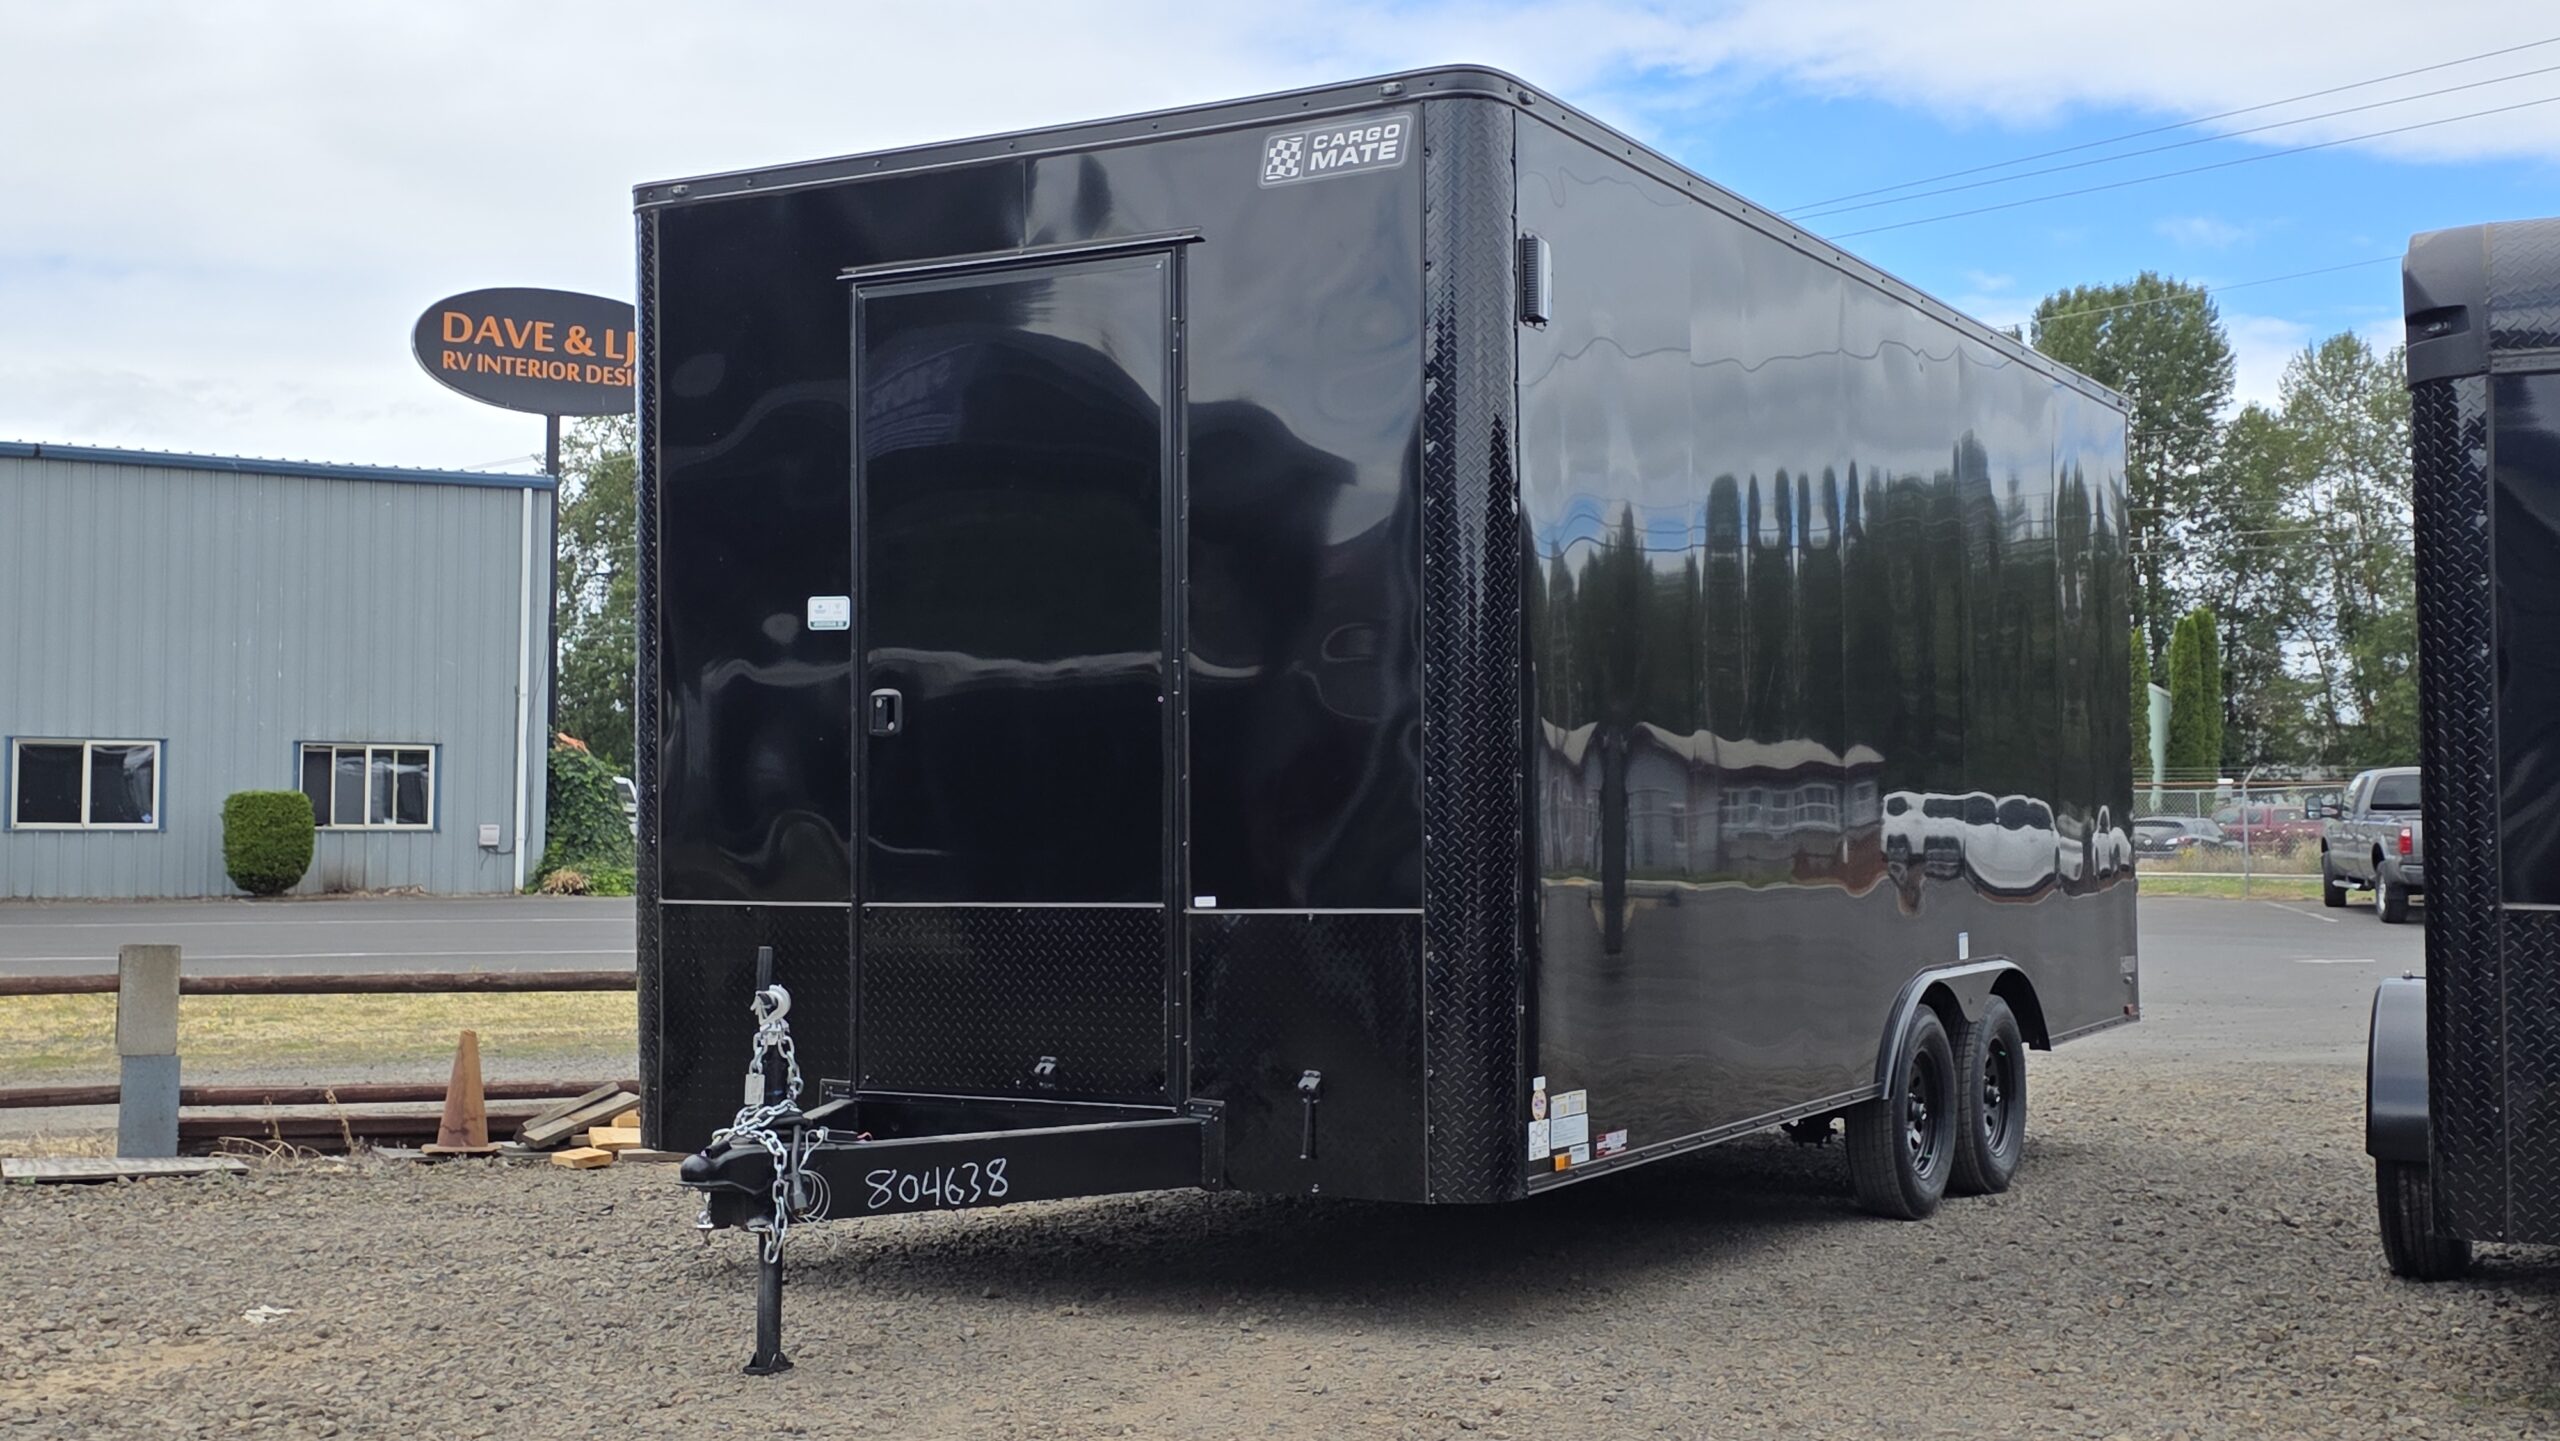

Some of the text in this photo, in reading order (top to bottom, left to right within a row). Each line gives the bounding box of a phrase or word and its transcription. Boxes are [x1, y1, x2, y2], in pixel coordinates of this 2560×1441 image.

[1309, 139, 1398, 171] MATE
[1313, 123, 1401, 150] CARGO
[442, 311, 555, 353] DAVE
[564, 325, 597, 357] &
[442, 350, 637, 387] RV INTERIOR DESI
[865, 1157, 1009, 1209] 804638
